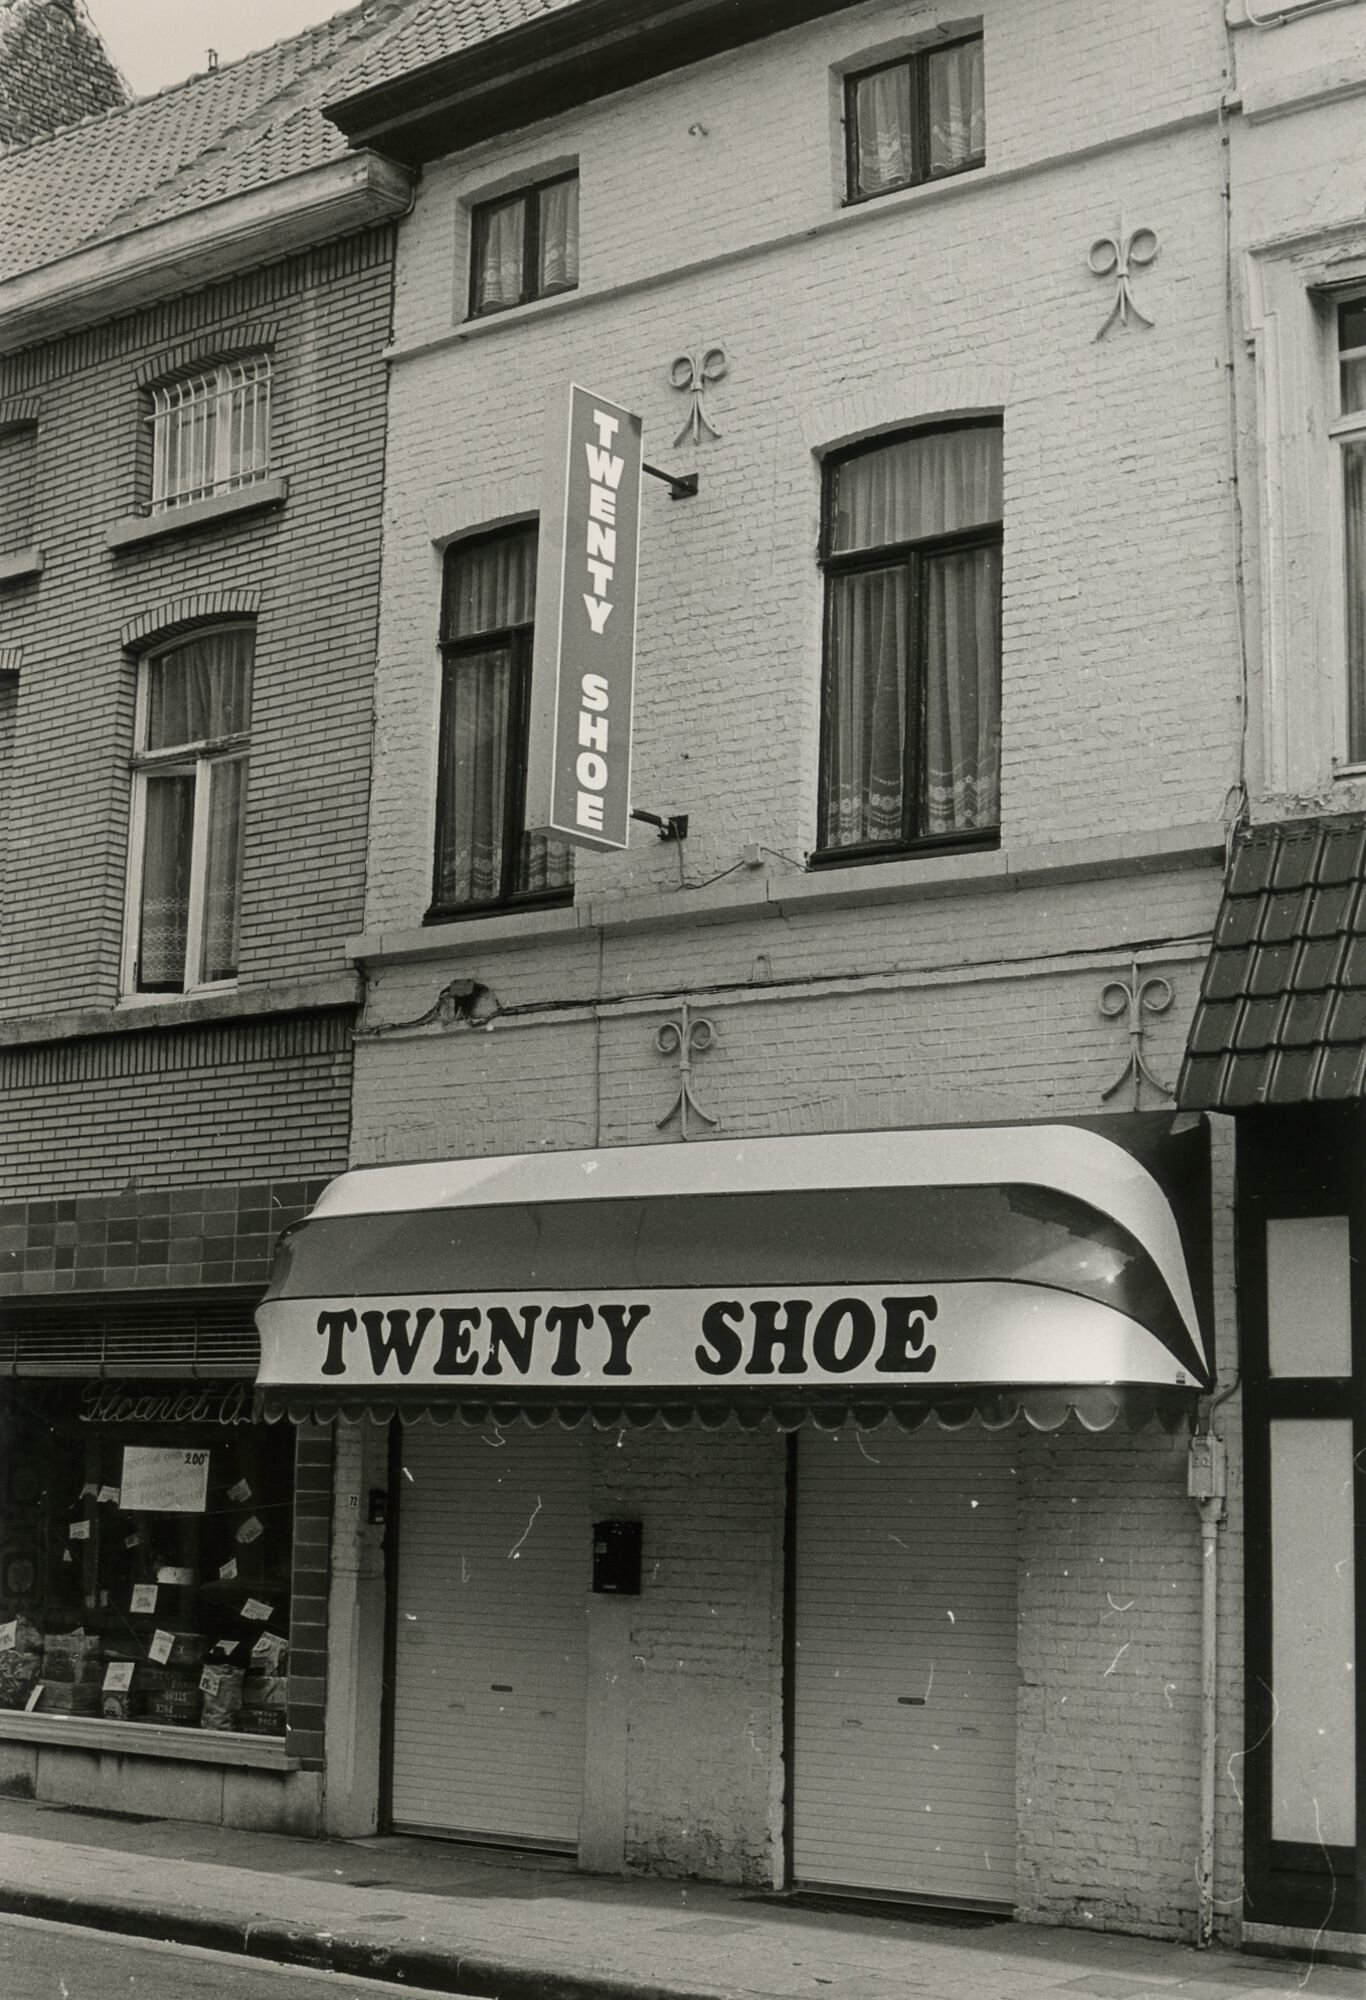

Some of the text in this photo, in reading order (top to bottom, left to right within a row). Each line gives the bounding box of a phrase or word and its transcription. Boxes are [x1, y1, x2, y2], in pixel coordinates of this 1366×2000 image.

[576, 408, 625, 831] TWENTY SHOE
[317, 1295, 938, 1376] TWENTY SHOE
